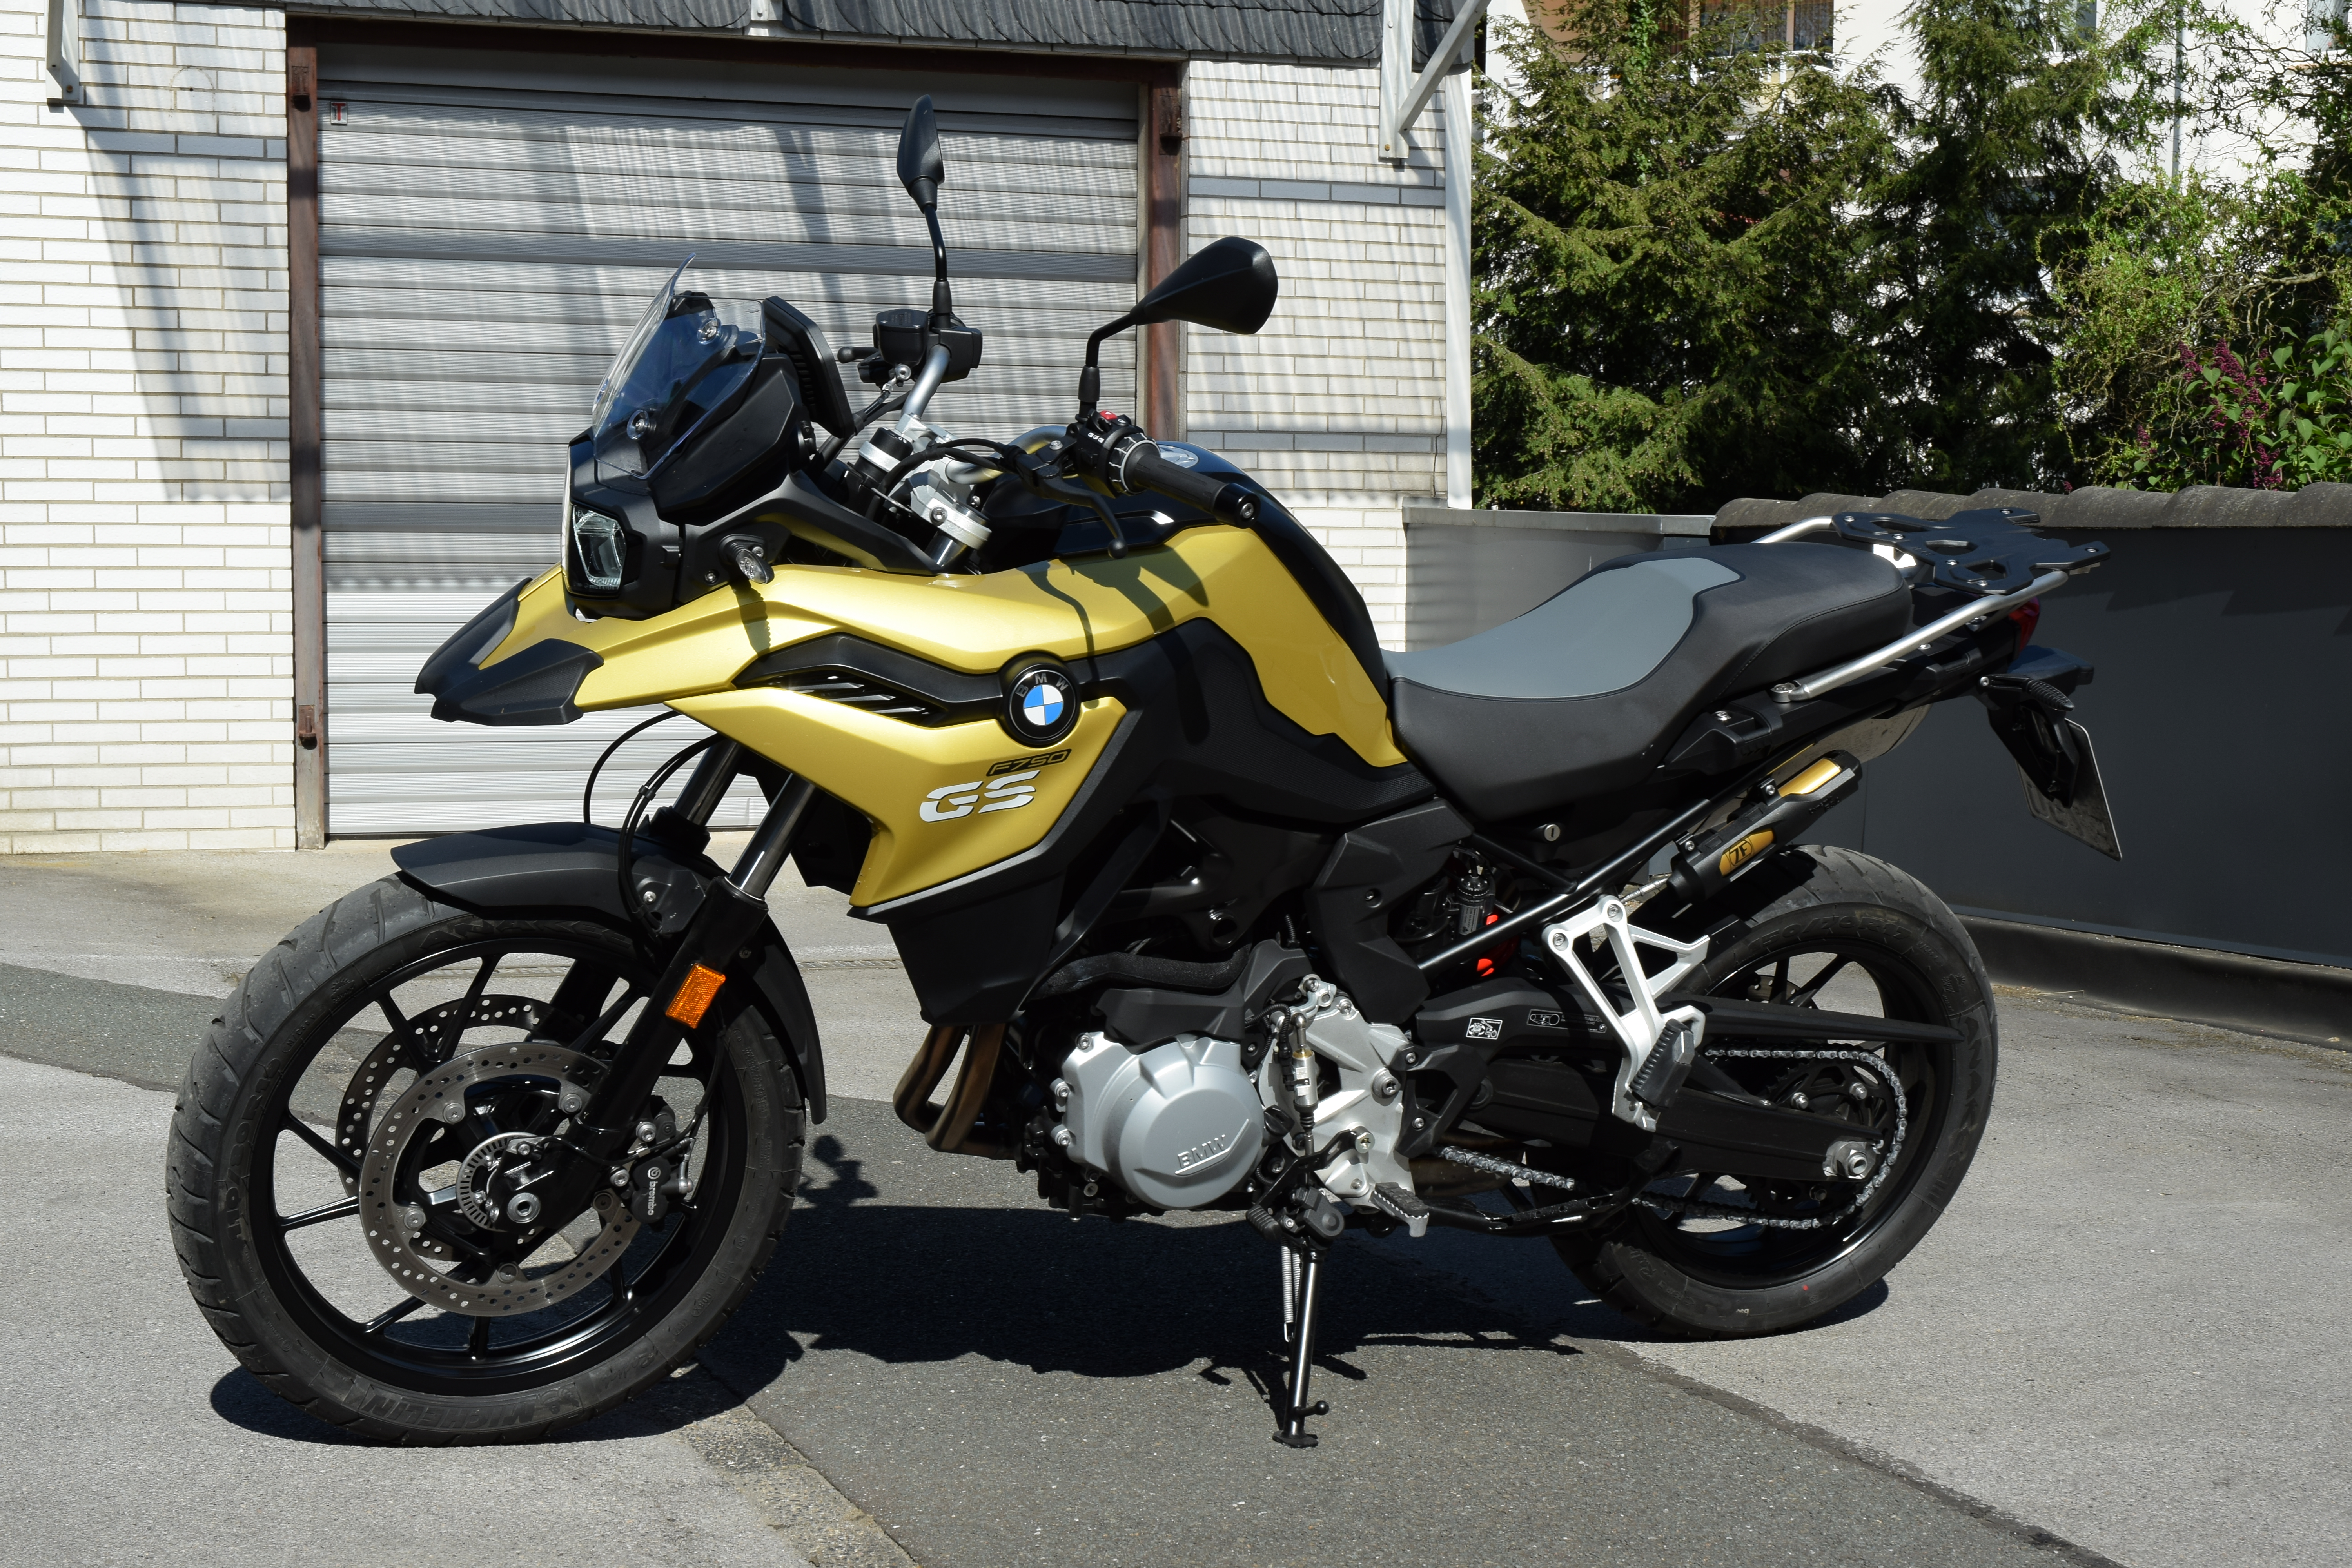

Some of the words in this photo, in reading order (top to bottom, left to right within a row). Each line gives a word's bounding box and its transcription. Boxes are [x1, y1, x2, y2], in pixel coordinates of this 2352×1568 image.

[1015, 672, 1069, 698] BMW
[991, 751, 1068, 775] F750
[919, 770, 1041, 822] GS
[1730, 841, 1748, 864] ZF
[419, 919, 633, 949] ANAKEE
[1747, 915, 1911, 953] 150/70R17
[227, 1058, 281, 1240] 110/80R19
[1177, 1134, 1226, 1169] BMW
[525, 1193, 537, 1202] BMW
[647, 1181, 659, 1216] brembo
[361, 1394, 538, 1430] MICHELIN
